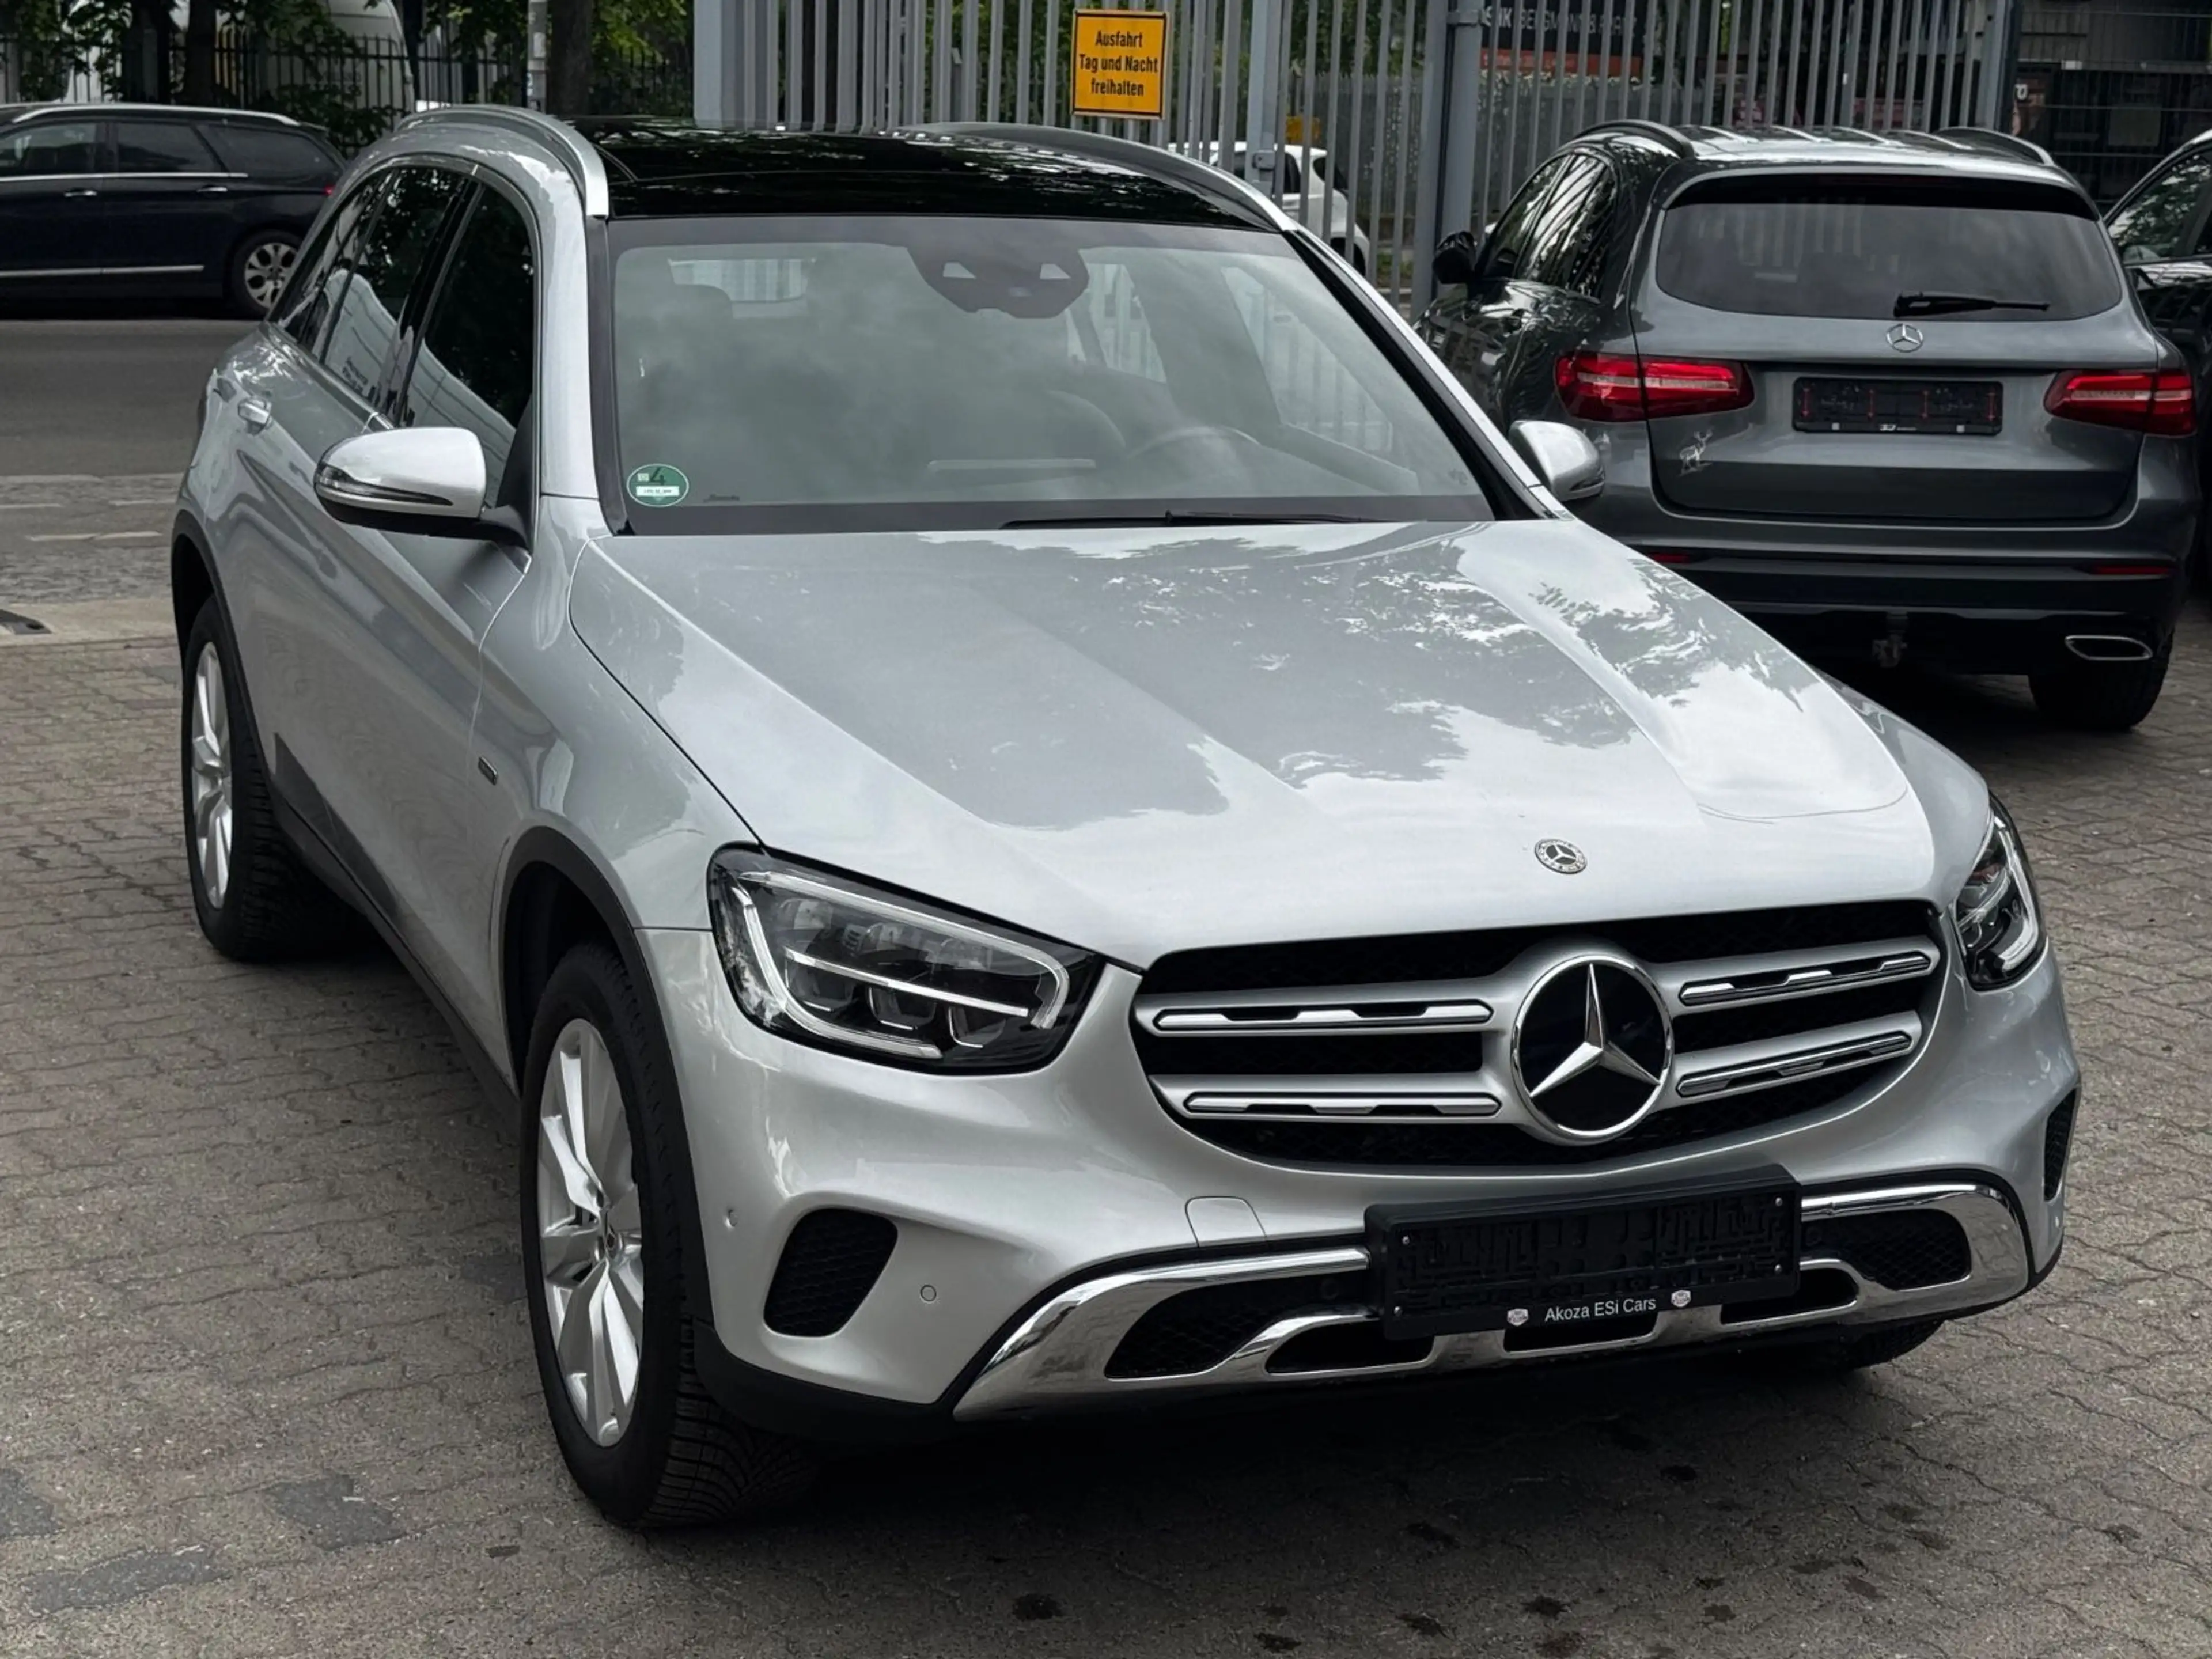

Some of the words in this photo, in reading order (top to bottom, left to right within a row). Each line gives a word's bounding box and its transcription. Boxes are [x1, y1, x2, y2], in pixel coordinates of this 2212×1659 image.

[1096, 31, 1143, 47] Ausfahrt
[1079, 54, 1097, 73] Tag
[1101, 56, 1122, 71] und
[1125, 56, 1158, 73] Nacht
[1090, 78, 1145, 96] freihalten
[650, 467, 666, 486] 4
[1544, 1306, 1590, 1323] Akoza
[1623, 1298, 1657, 1313] Cars
